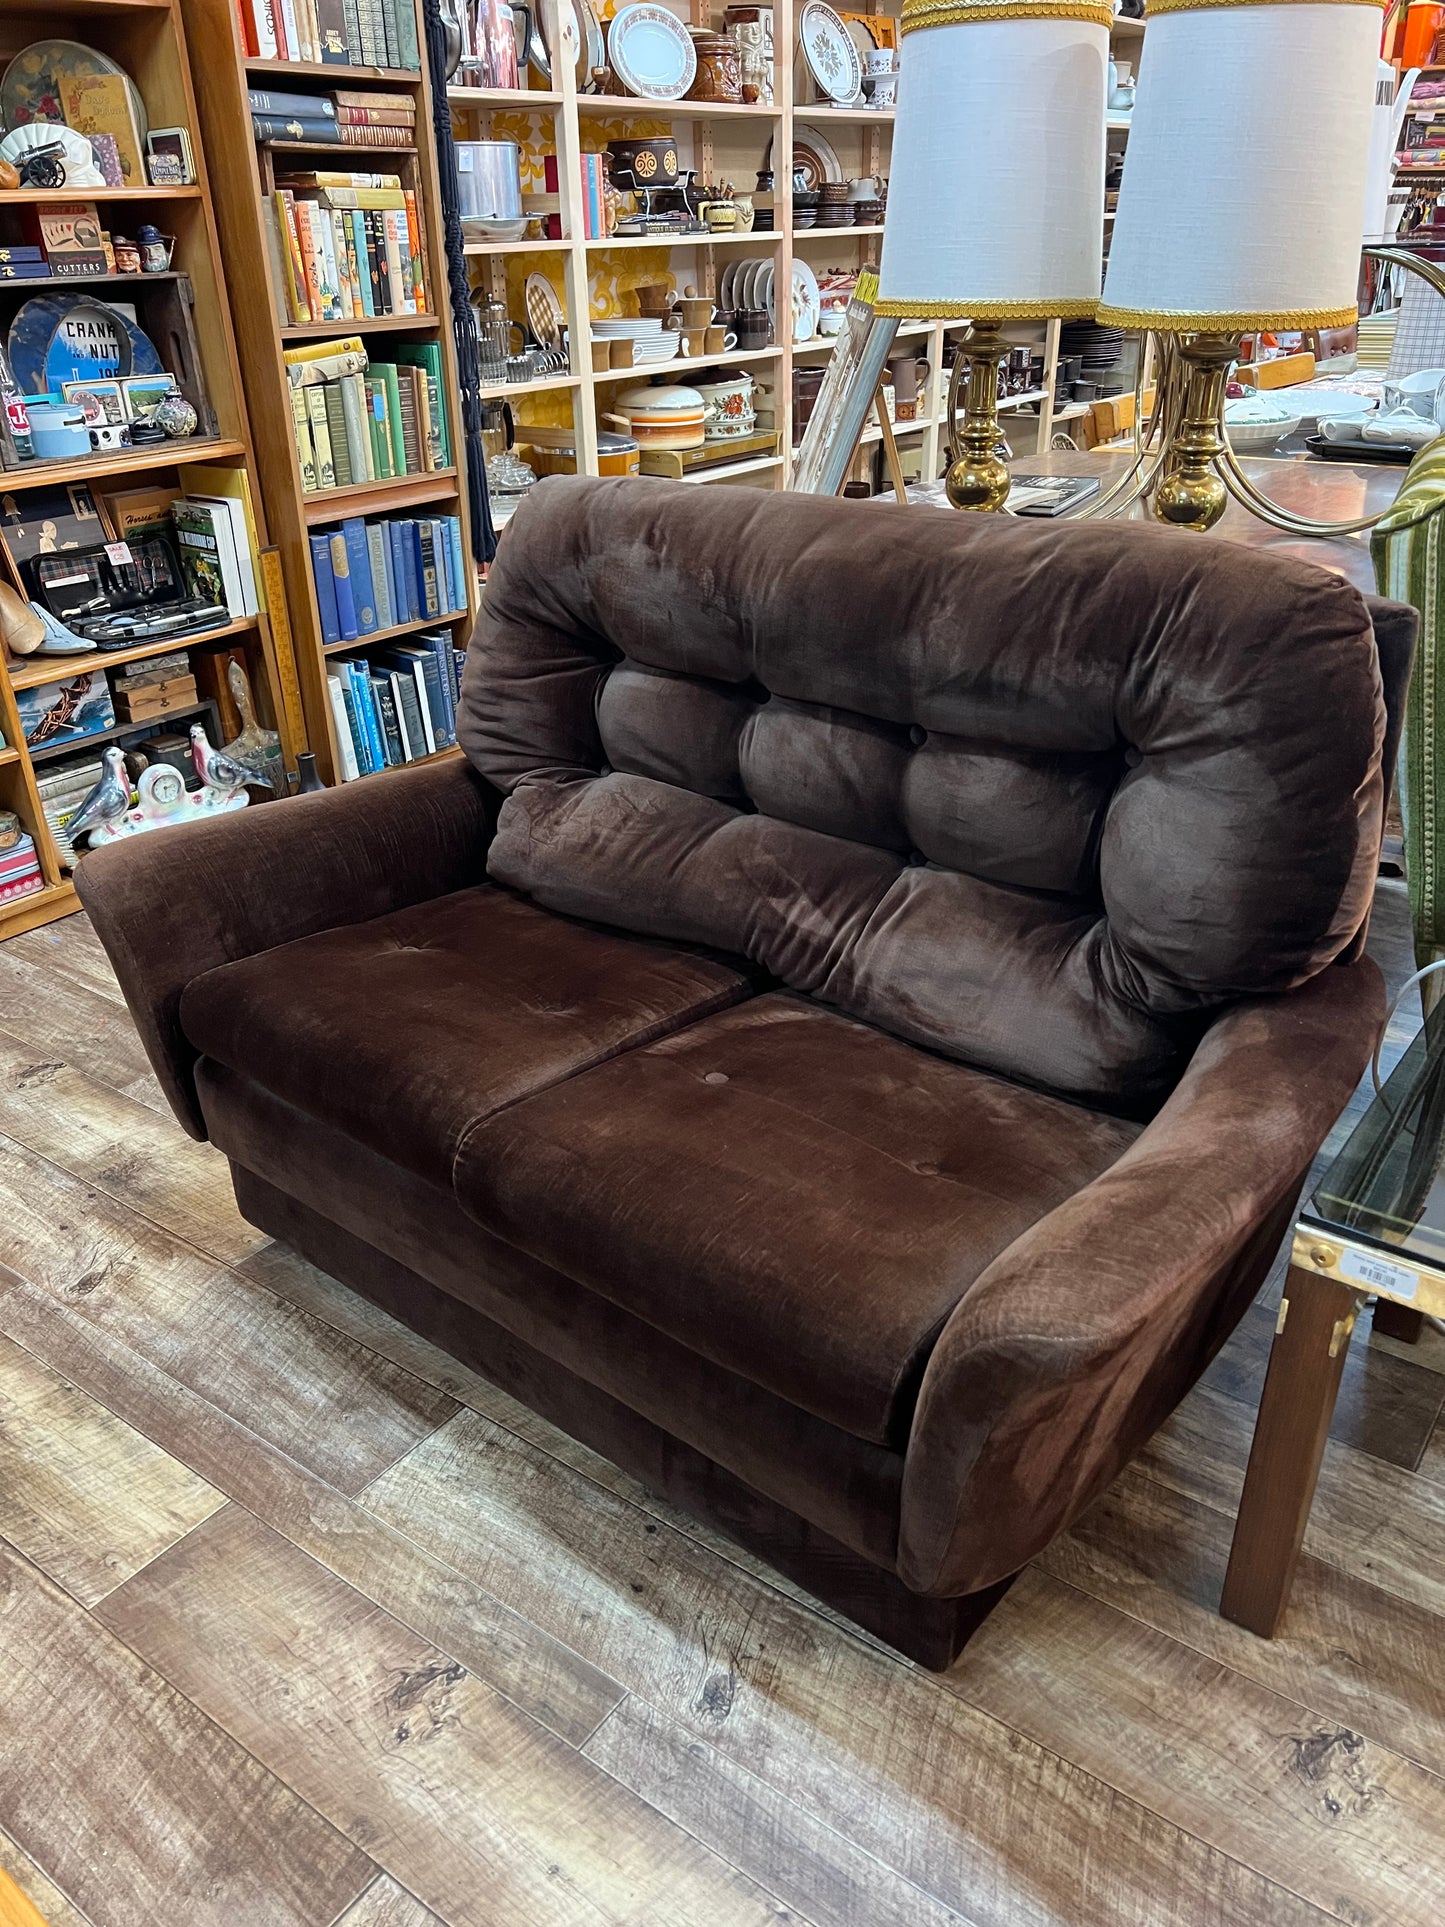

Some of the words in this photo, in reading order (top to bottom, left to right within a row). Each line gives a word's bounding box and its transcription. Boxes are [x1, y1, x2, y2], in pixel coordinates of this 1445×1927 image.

[57, 263, 100, 272] CUTTERS
[66, 322, 116, 338] CRANK
[89, 344, 118, 359] NUT
